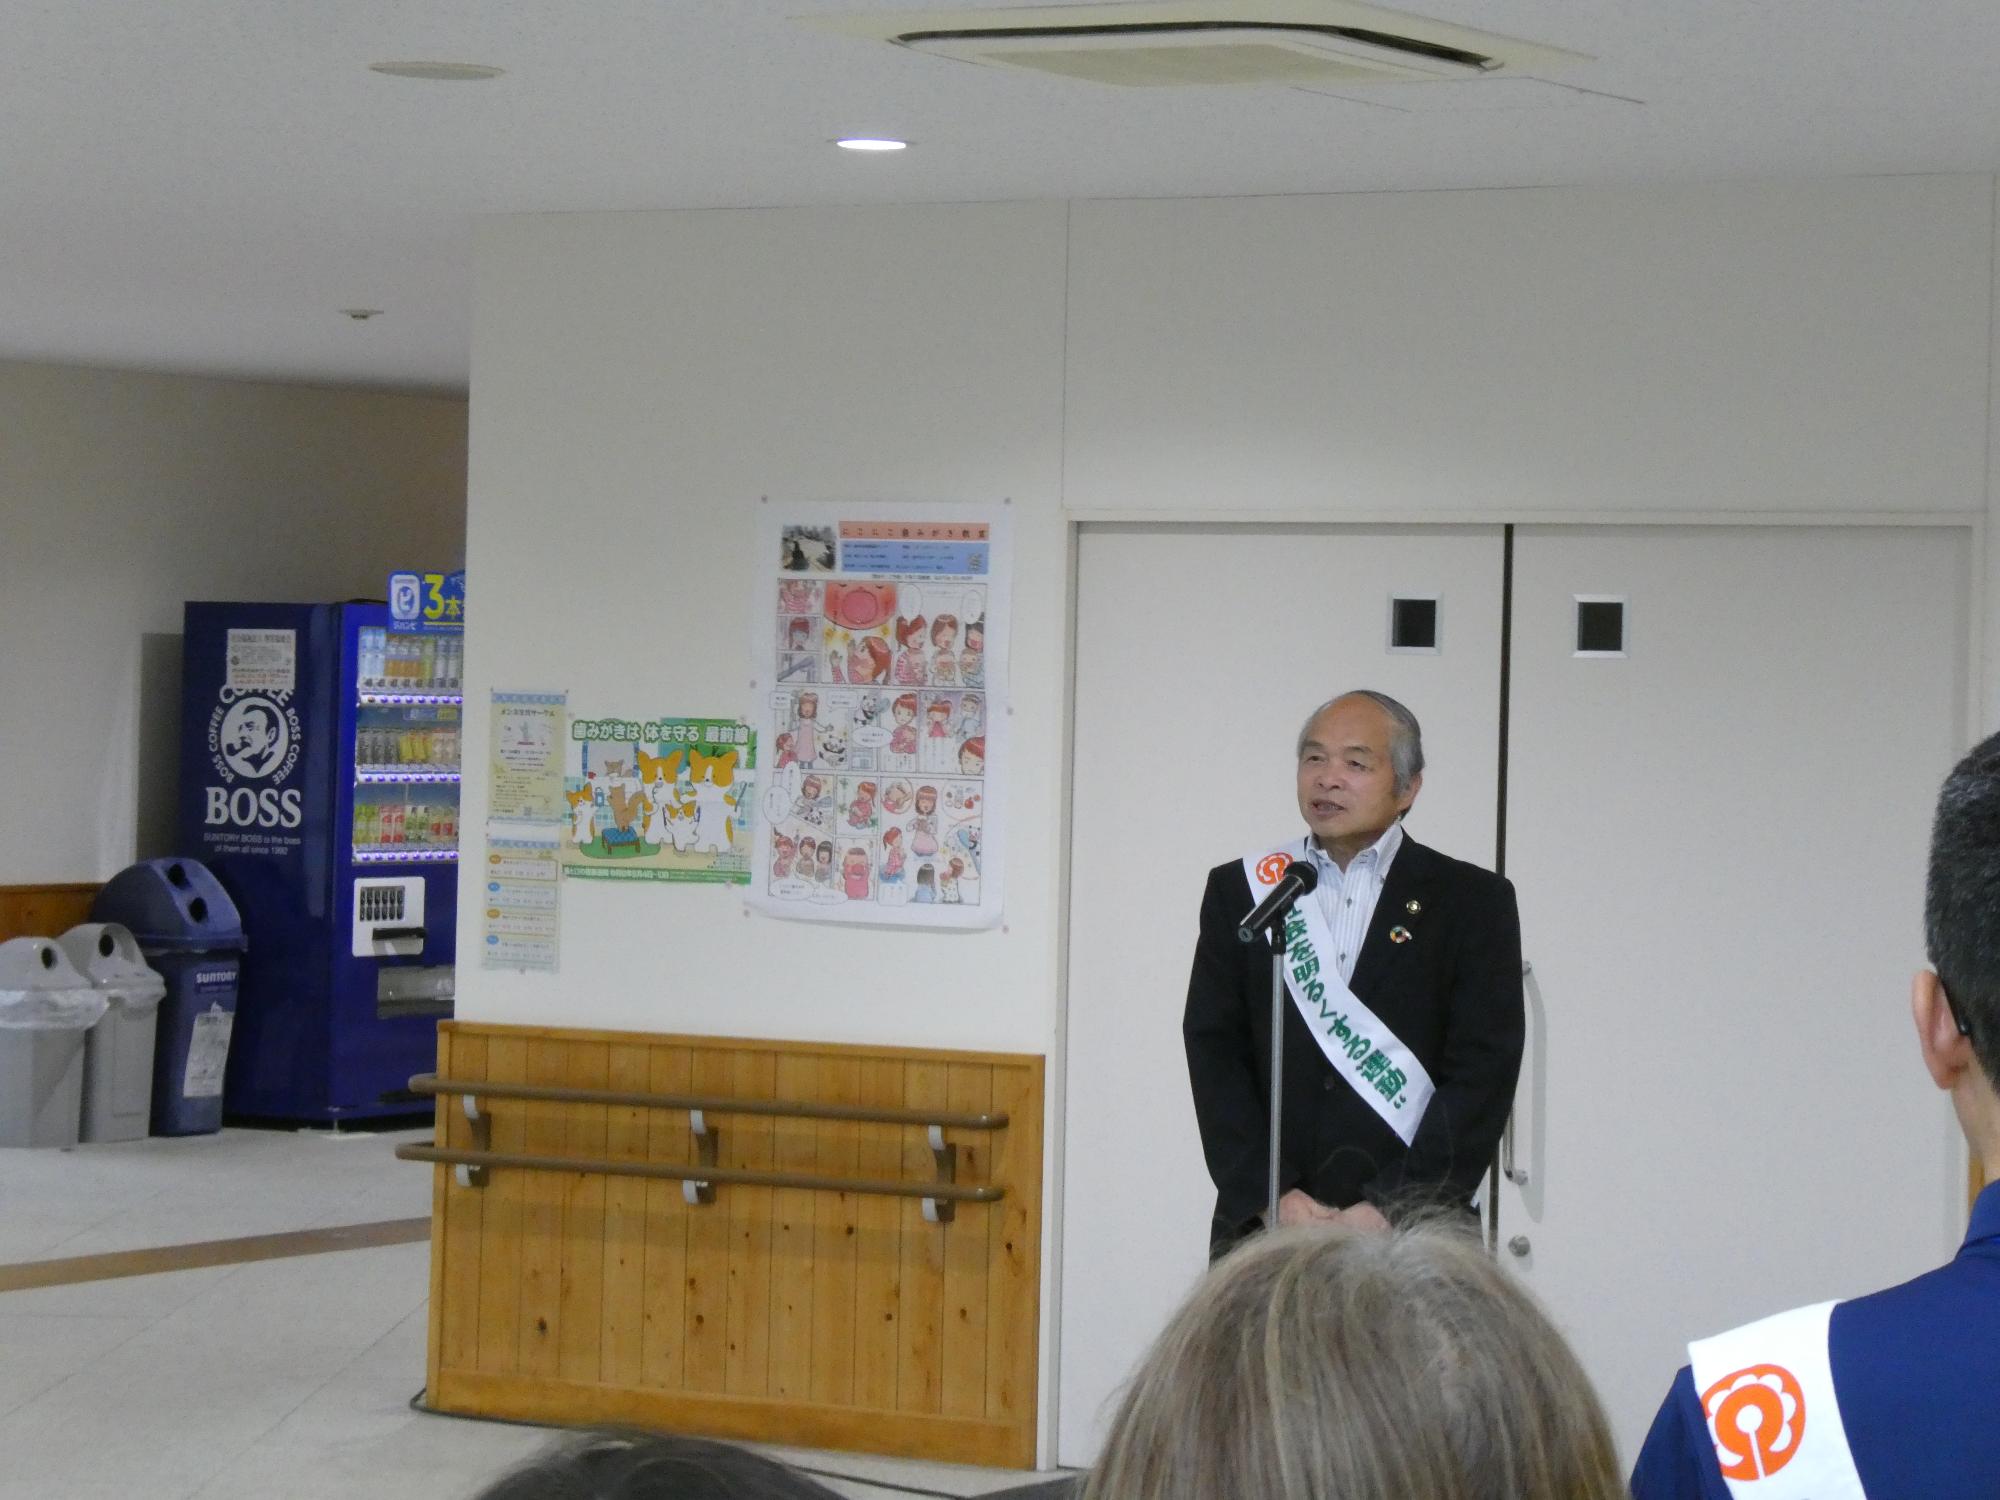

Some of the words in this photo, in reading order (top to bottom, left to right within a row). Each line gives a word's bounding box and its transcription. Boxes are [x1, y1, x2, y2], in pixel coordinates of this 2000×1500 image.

[208, 705, 225, 752] COFFEE
[286, 707, 301, 741] BOSS
[572, 720, 641, 741] 歯みがきは
[644, 722, 700, 743] 体を守る
[212, 754, 235, 784] BOSS
[272, 744, 300, 785] COFFEE
[204, 786, 302, 828] BOSS
[203, 832, 240, 842] SUNTORY
[241, 833, 262, 844] BOSS
[196, 971, 238, 984] SUNTORY
